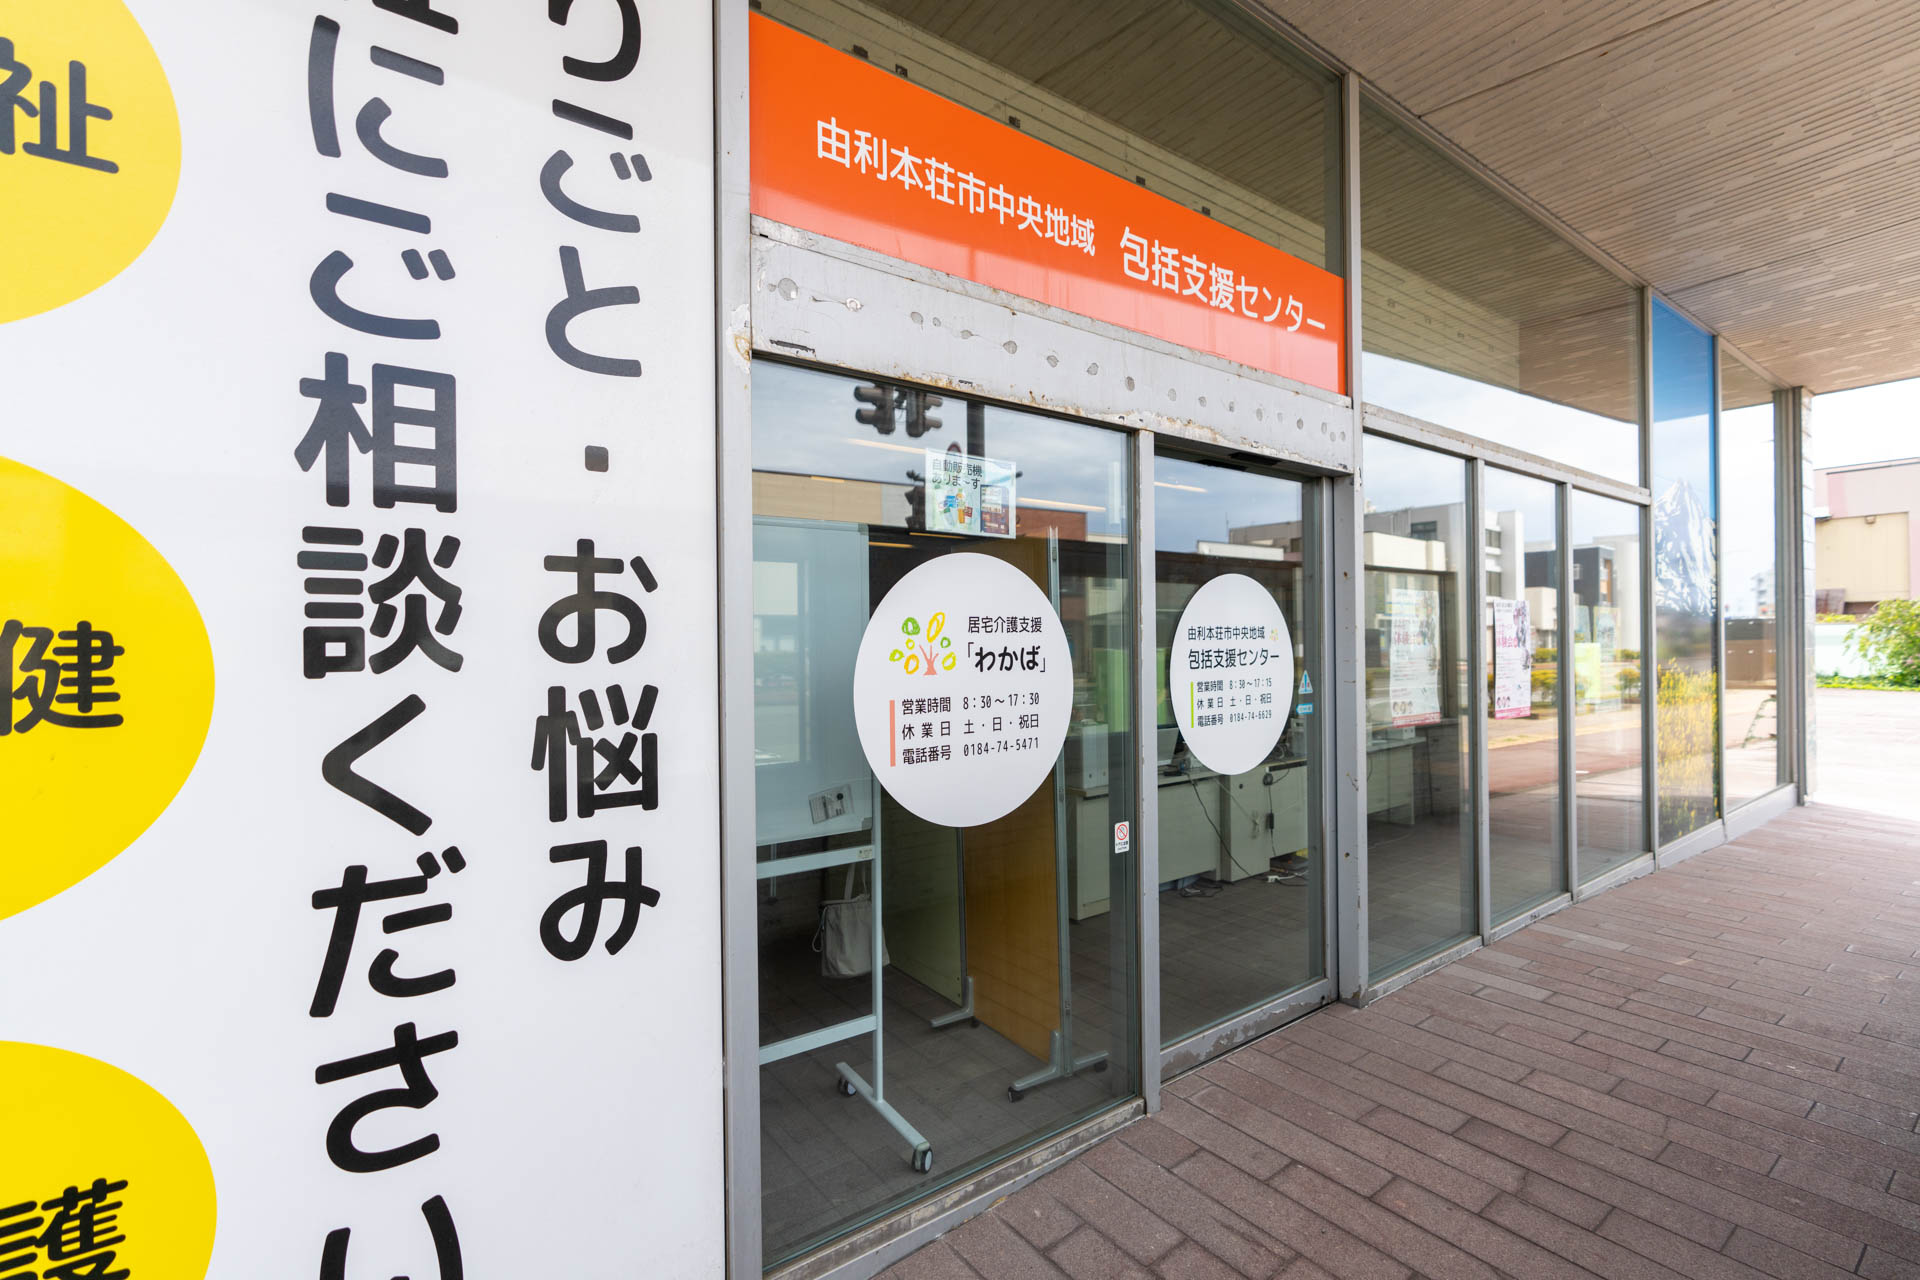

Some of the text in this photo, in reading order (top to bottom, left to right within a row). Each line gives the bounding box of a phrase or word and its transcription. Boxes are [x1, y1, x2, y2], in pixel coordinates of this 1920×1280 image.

[816, 117, 1327, 332] 由利本荘市中央地域 包括支援センター
[968, 616, 1042, 633] 居宅介護支援
[1187, 626, 1265, 640] 由利本荘市中央地域
[967, 642, 1046, 672] 「わかば」
[1188, 648, 1279, 669] 包括支援センター
[1196, 680, 1224, 693] 営業時間
[901, 697, 951, 715] 営業時間
[1197, 713, 1224, 727] 電話番号
[902, 737, 1039, 765] 電話番号 0184-74-5471
